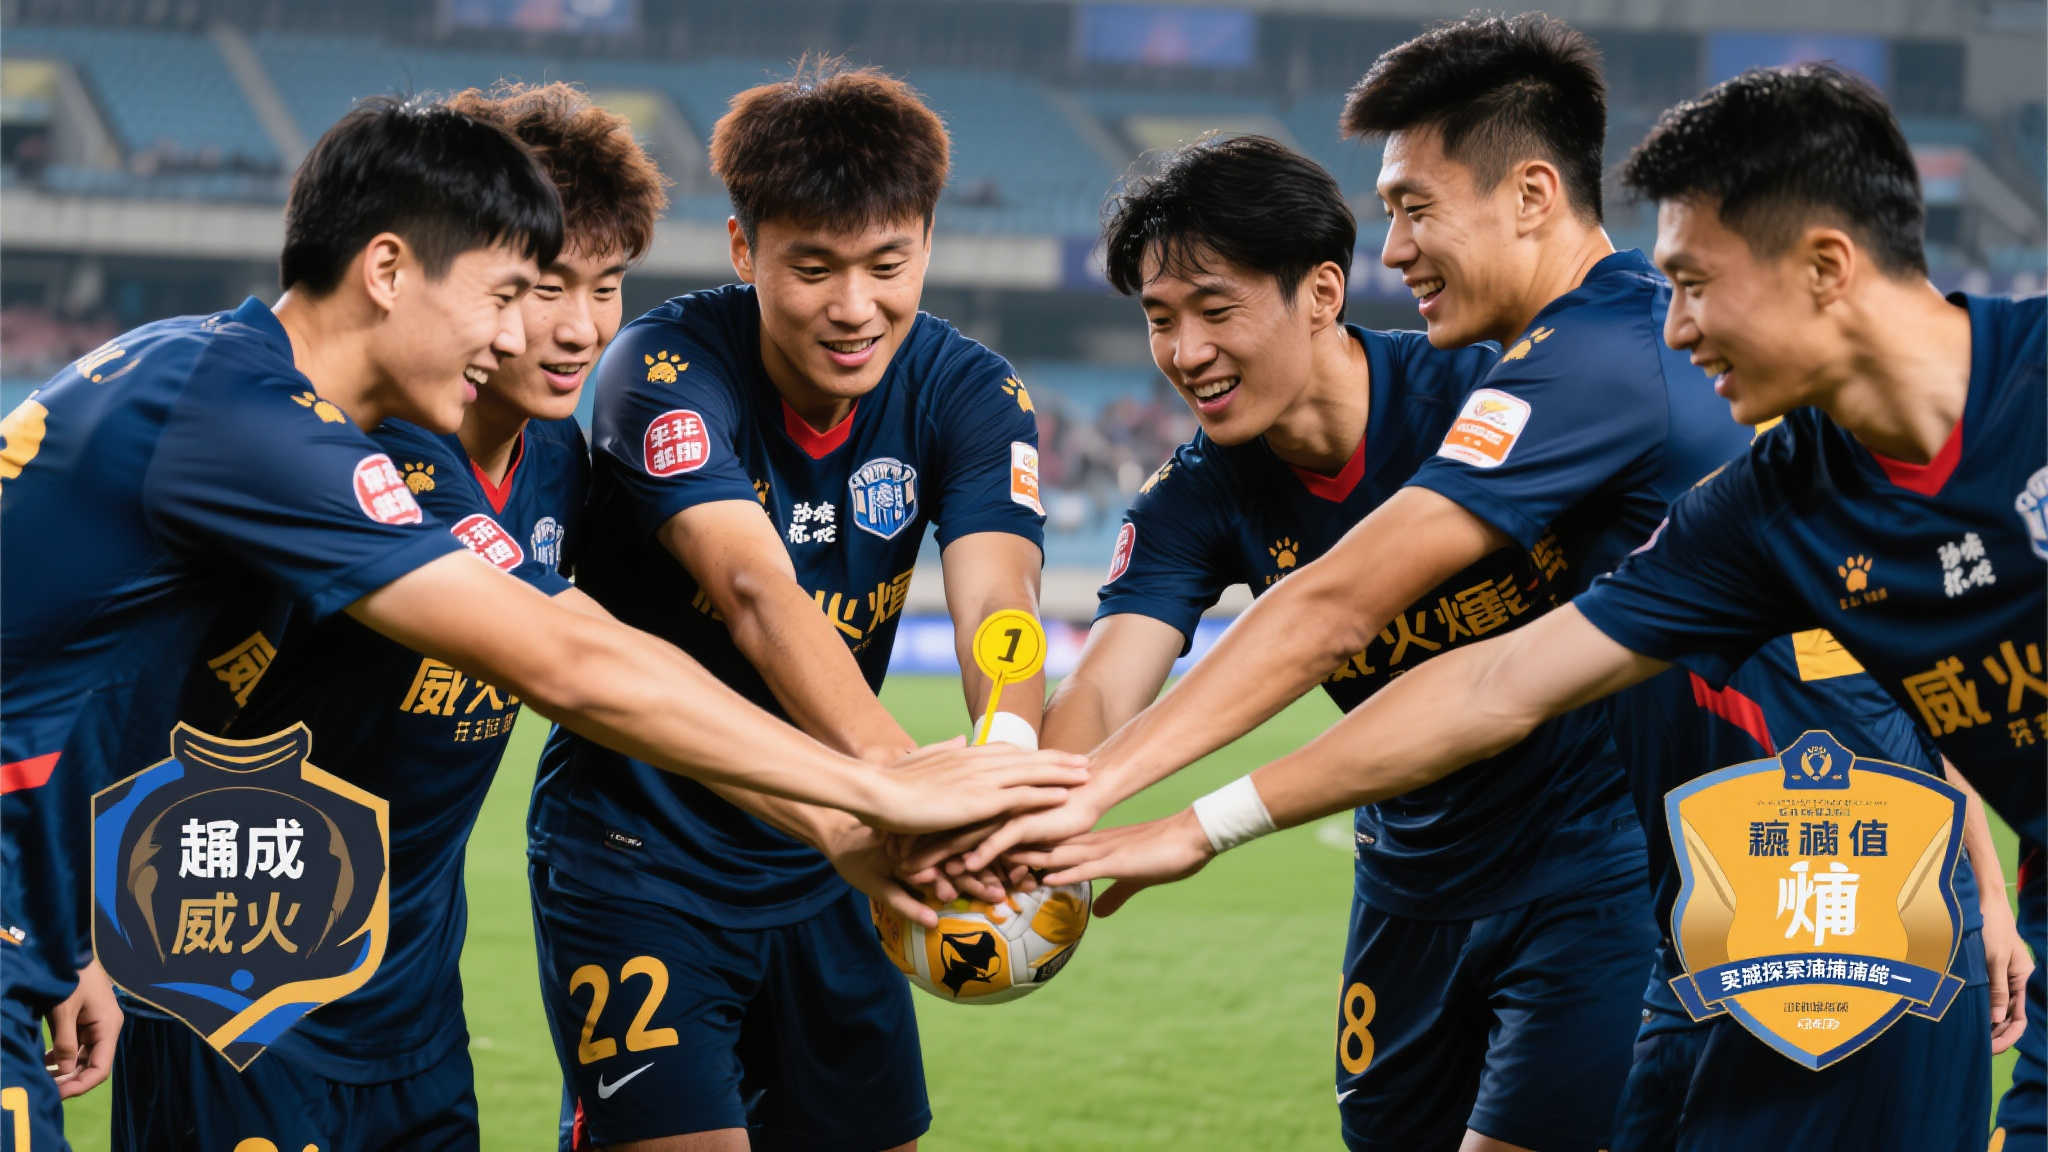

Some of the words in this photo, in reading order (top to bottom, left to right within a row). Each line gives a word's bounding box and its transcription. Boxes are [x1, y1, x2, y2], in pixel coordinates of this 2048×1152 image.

[997, 628, 1022, 663] 1
[1902, 641, 2047, 737] 威火
[569, 955, 679, 1065] 22
